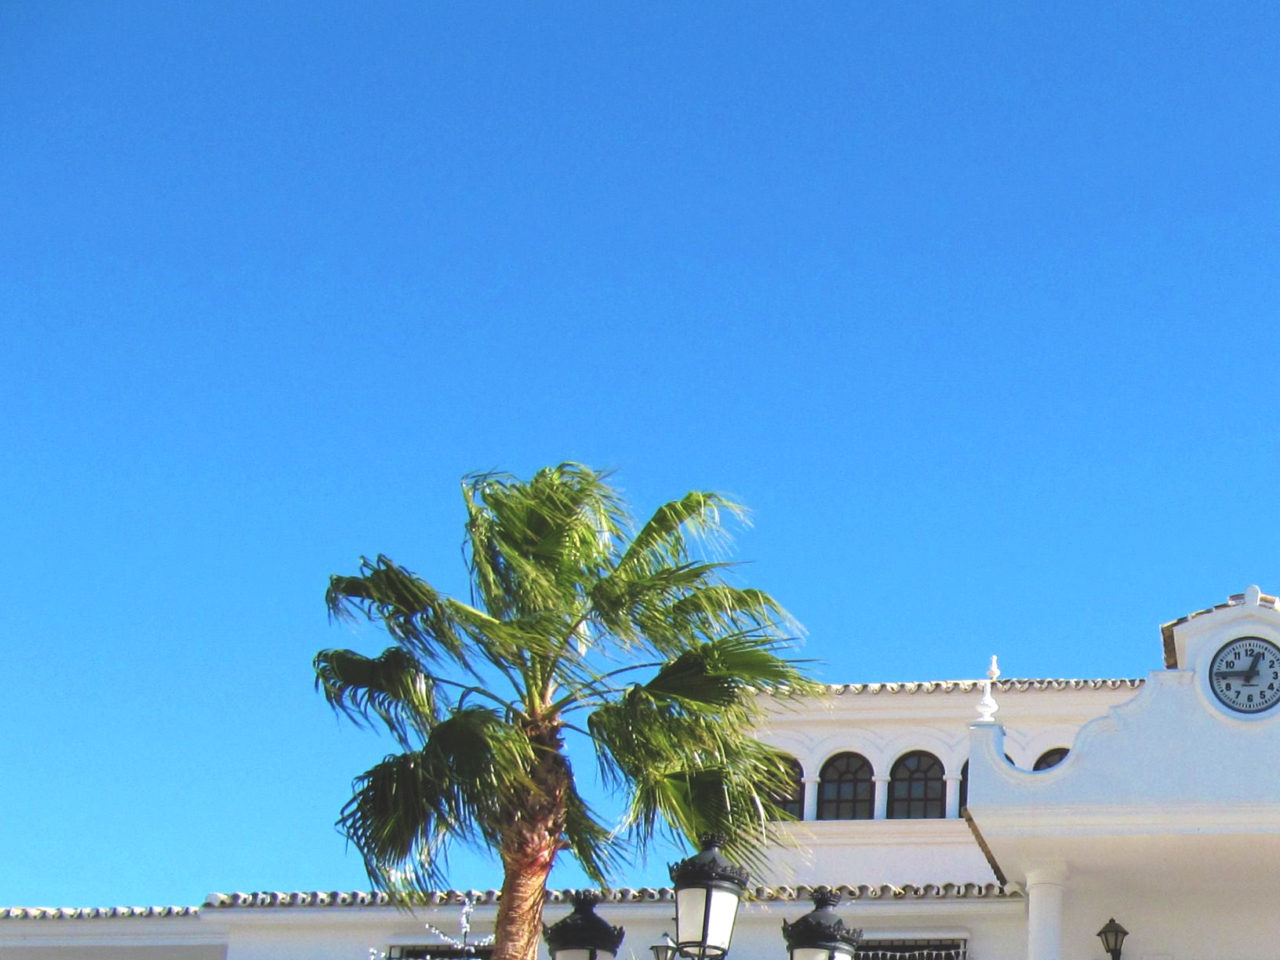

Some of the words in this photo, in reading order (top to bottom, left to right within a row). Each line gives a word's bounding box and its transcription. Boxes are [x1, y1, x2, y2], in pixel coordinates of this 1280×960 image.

[1234, 652, 1240, 660] 11
[1245, 649, 1255, 657] 12
[1225, 661, 1235, 669] 10
[1269, 660, 1275, 668] 2
[1272, 671, 1278, 680] 3
[1225, 683, 1231, 691] 8
[1267, 683, 1274, 691] 4
[1234, 691, 1241, 699] 7
[1247, 694, 1253, 702] 6
[1260, 691, 1266, 699] 5
